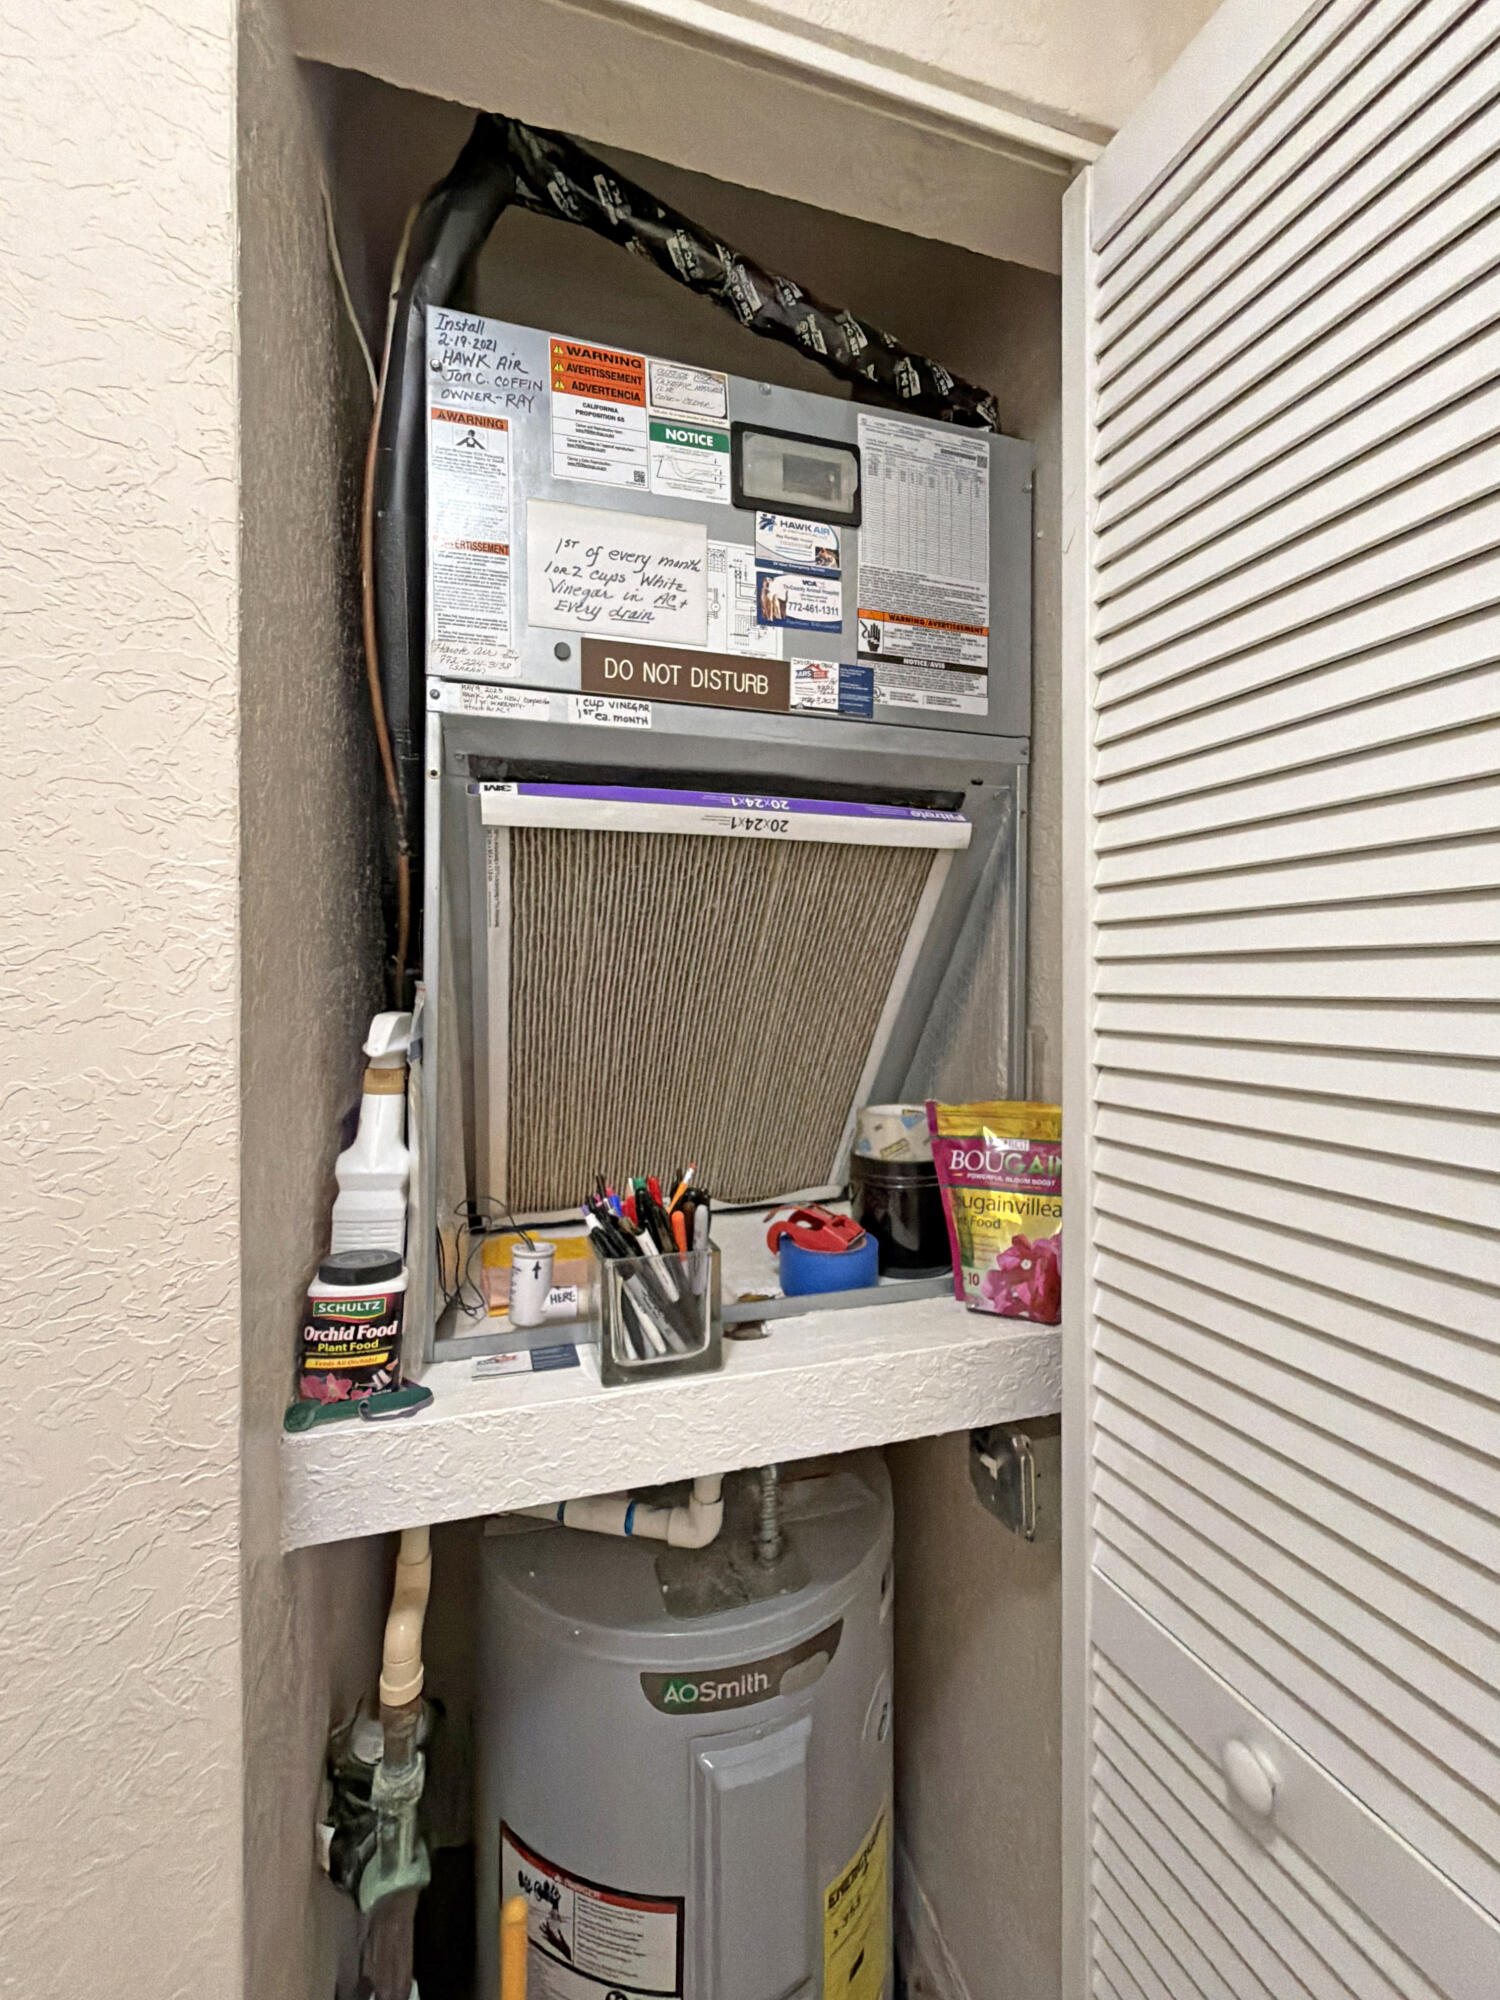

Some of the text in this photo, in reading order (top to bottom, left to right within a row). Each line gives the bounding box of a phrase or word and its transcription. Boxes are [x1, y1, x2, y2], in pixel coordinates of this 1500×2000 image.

[435, 313, 485, 335] Install
[442, 349, 491, 368] HAWK
[566, 345, 642, 369] WARNING
[566, 363, 643, 385] AVERTISSEMENT
[495, 376, 543, 391] COFFIN
[571, 381, 641, 402] ADVERTENCIA
[575, 409, 617, 421] PROPOSITION
[582, 402, 618, 414] CALIFORNIA
[446, 410, 504, 430] WARNING
[665, 428, 714, 447] NOTICE
[780, 520, 830, 536] HAWK AIR
[444, 540, 510, 556] ERTISSEMENT
[586, 546, 604, 567] of
[608, 550, 651, 574] every
[549, 578, 613, 603] Vinegar
[623, 588, 644, 602] in
[640, 572, 687, 592] White
[802, 579, 818, 587] VCA
[608, 606, 655, 623] drain
[788, 601, 839, 616] 772-461-1311
[604, 657, 634, 681] DO
[643, 661, 682, 686] NOT
[691, 666, 769, 695] DISTURB
[484, 784, 512, 792] 3M
[731, 796, 790, 810] 20x24x1
[730, 816, 789, 833] 20x24x1
[1031, 1178, 1056, 1187] BOOST
[960, 1195, 1062, 1218] ugainvillea
[318, 1300, 381, 1313] SCHULTZ
[550, 1291, 576, 1305] HERE
[304, 1320, 399, 1342] Orchid Food
[317, 1339, 380, 1353] Plant Food
